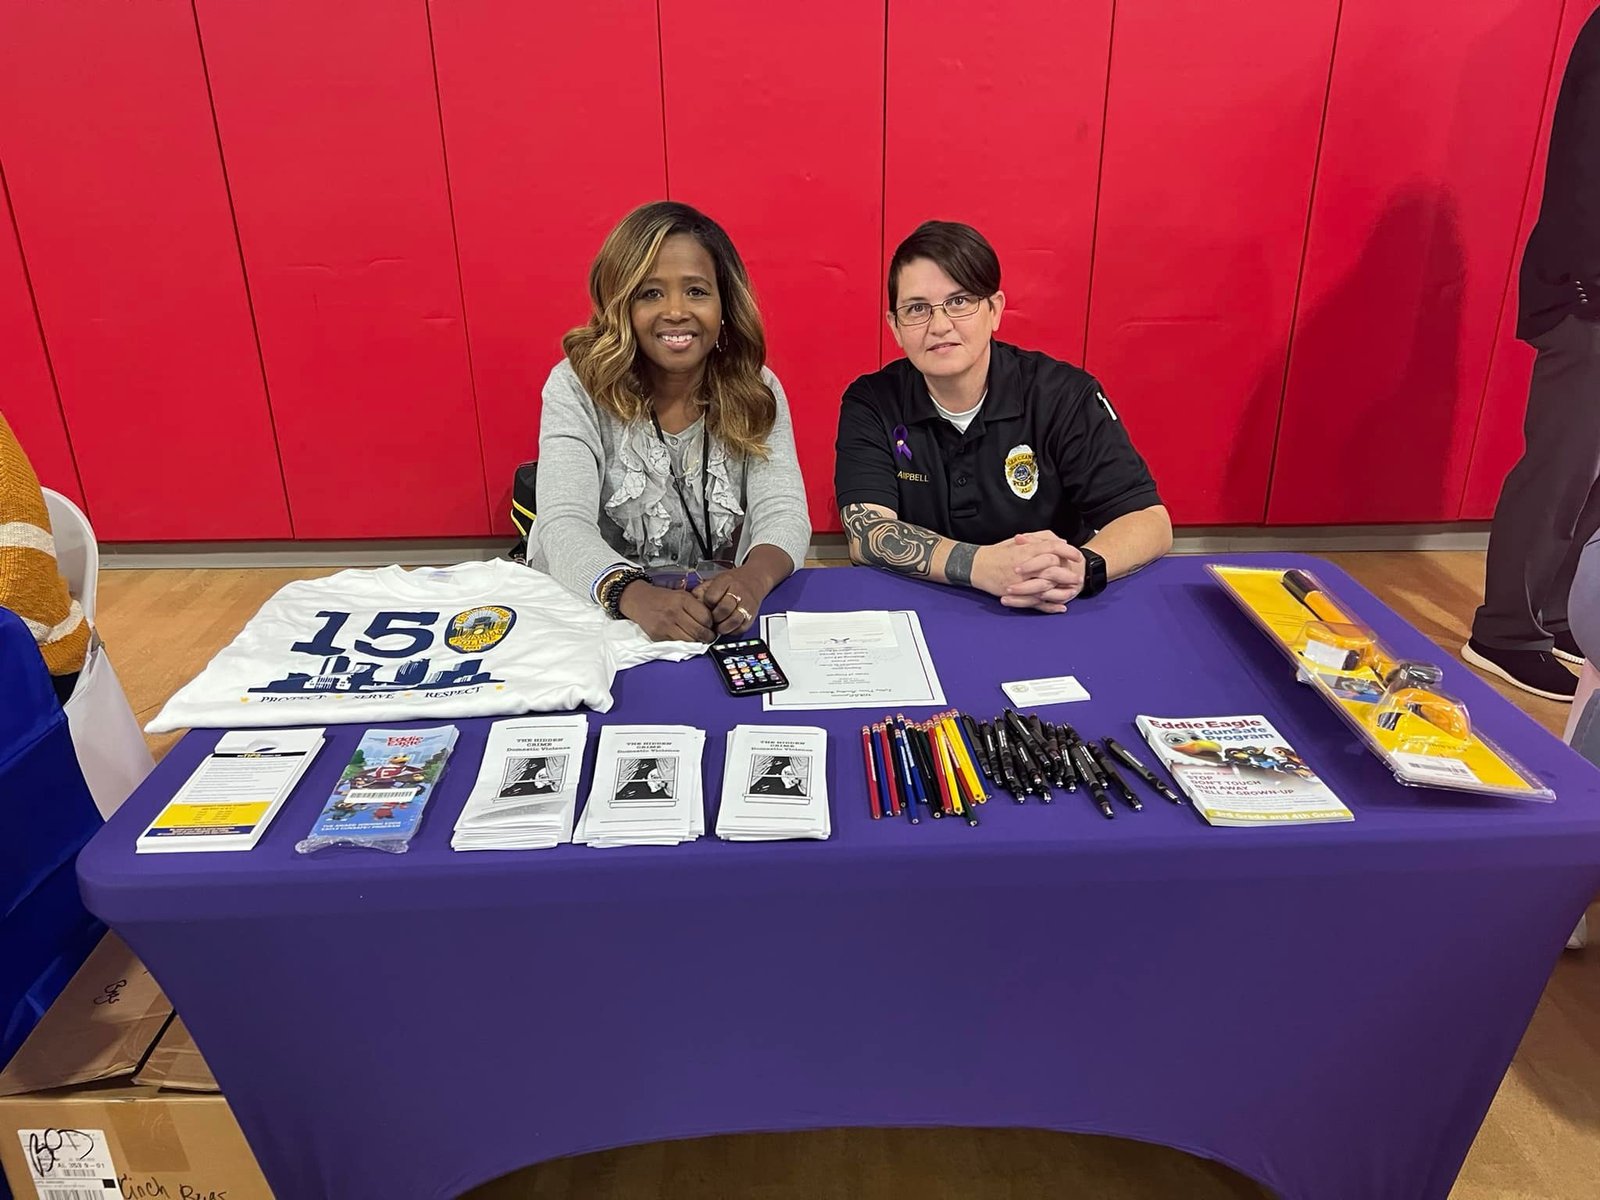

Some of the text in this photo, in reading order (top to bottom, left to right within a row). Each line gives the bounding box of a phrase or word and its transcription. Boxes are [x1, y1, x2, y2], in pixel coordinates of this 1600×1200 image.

[897, 470, 929, 482] AMPBELL
[352, 692, 396, 701] SERVE
[424, 686, 483, 698] RESPECT
[1148, 719, 1262, 730] Eddie Eagle
[1201, 727, 1268, 736] GunSafe
[387, 735, 424, 743] Eddie
[1205, 733, 1275, 742] Program
